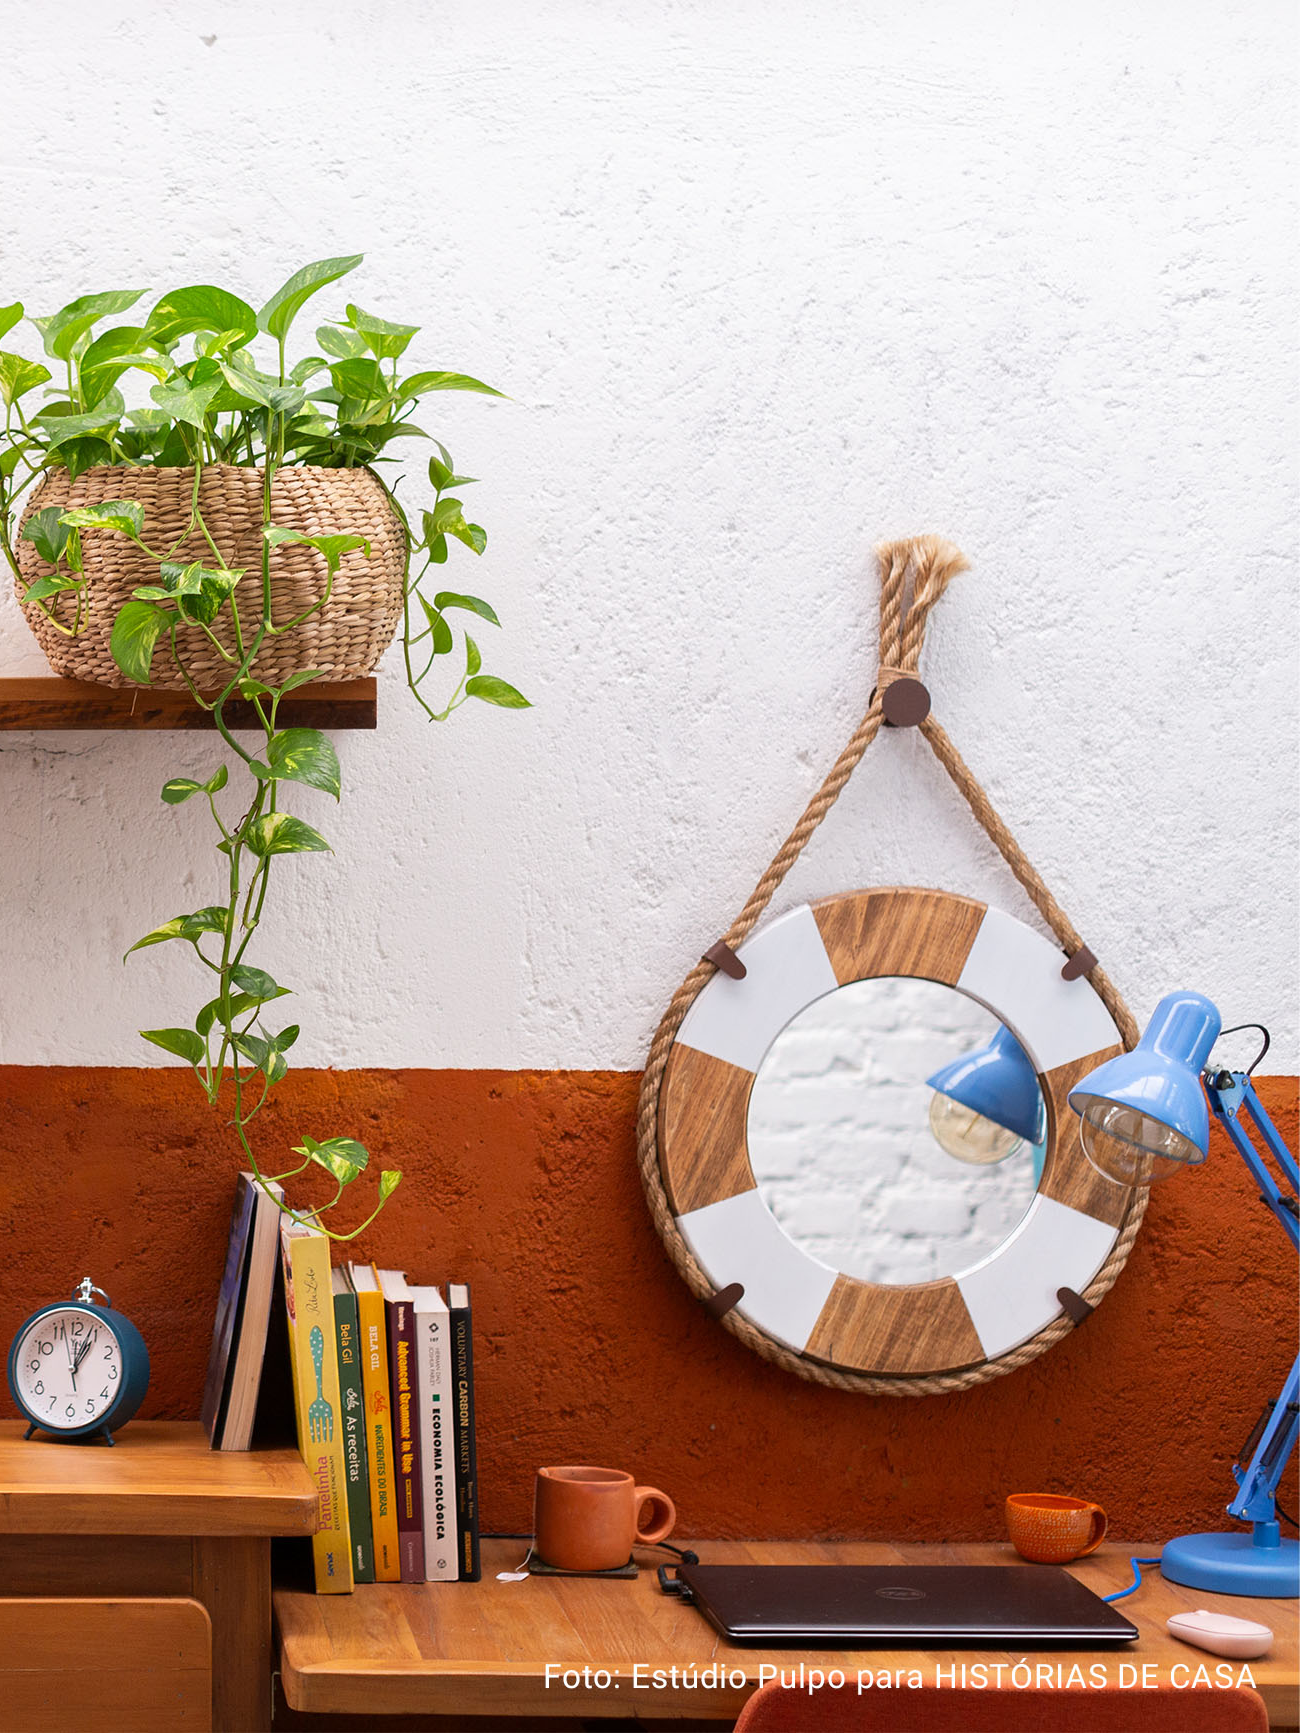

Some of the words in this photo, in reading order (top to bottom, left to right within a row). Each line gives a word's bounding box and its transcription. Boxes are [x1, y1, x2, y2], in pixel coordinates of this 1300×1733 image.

[53, 1325, 65, 1340] 11
[71, 1321, 84, 1336] 12
[93, 1328, 98, 1343] 1
[340, 1323, 352, 1346] Bela
[37, 1340, 54, 1355] 10
[369, 1326, 379, 1351] BELA
[103, 1345, 113, 1360] 2
[342, 1348, 353, 1364] Gil
[457, 1320, 467, 1378] VOLUNTARY
[30, 1359, 40, 1374] 9
[371, 1353, 380, 1371] GIL
[397, 1341, 411, 1391] Advanced
[108, 1365, 118, 1380] 3
[34, 1380, 45, 1395] 8
[99, 1385, 109, 1400] 4
[49, 1395, 57, 1410] 7
[65, 1403, 75, 1418] 6
[85, 1399, 95, 1414] 5
[459, 1381, 469, 1427] CARBON
[346, 1416, 358, 1431] As
[400, 1392, 411, 1439] Grammar
[401, 1441, 413, 1452] in
[432, 1408, 442, 1470] ECONOMIA
[347, 1434, 360, 1482] receitas
[374, 1424, 386, 1476] INGREDIENTES
[460, 1430, 470, 1473] MARKETS
[401, 1453, 413, 1474] Use
[329, 1456, 337, 1490] FUNCIONAM
[377, 1478, 387, 1489] DO
[314, 1456, 333, 1531] Panelinha
[379, 1491, 388, 1517] BRASIL
[435, 1475, 446, 1540] ECOLÓGICA
[332, 1503, 340, 1531] RECEITAS
